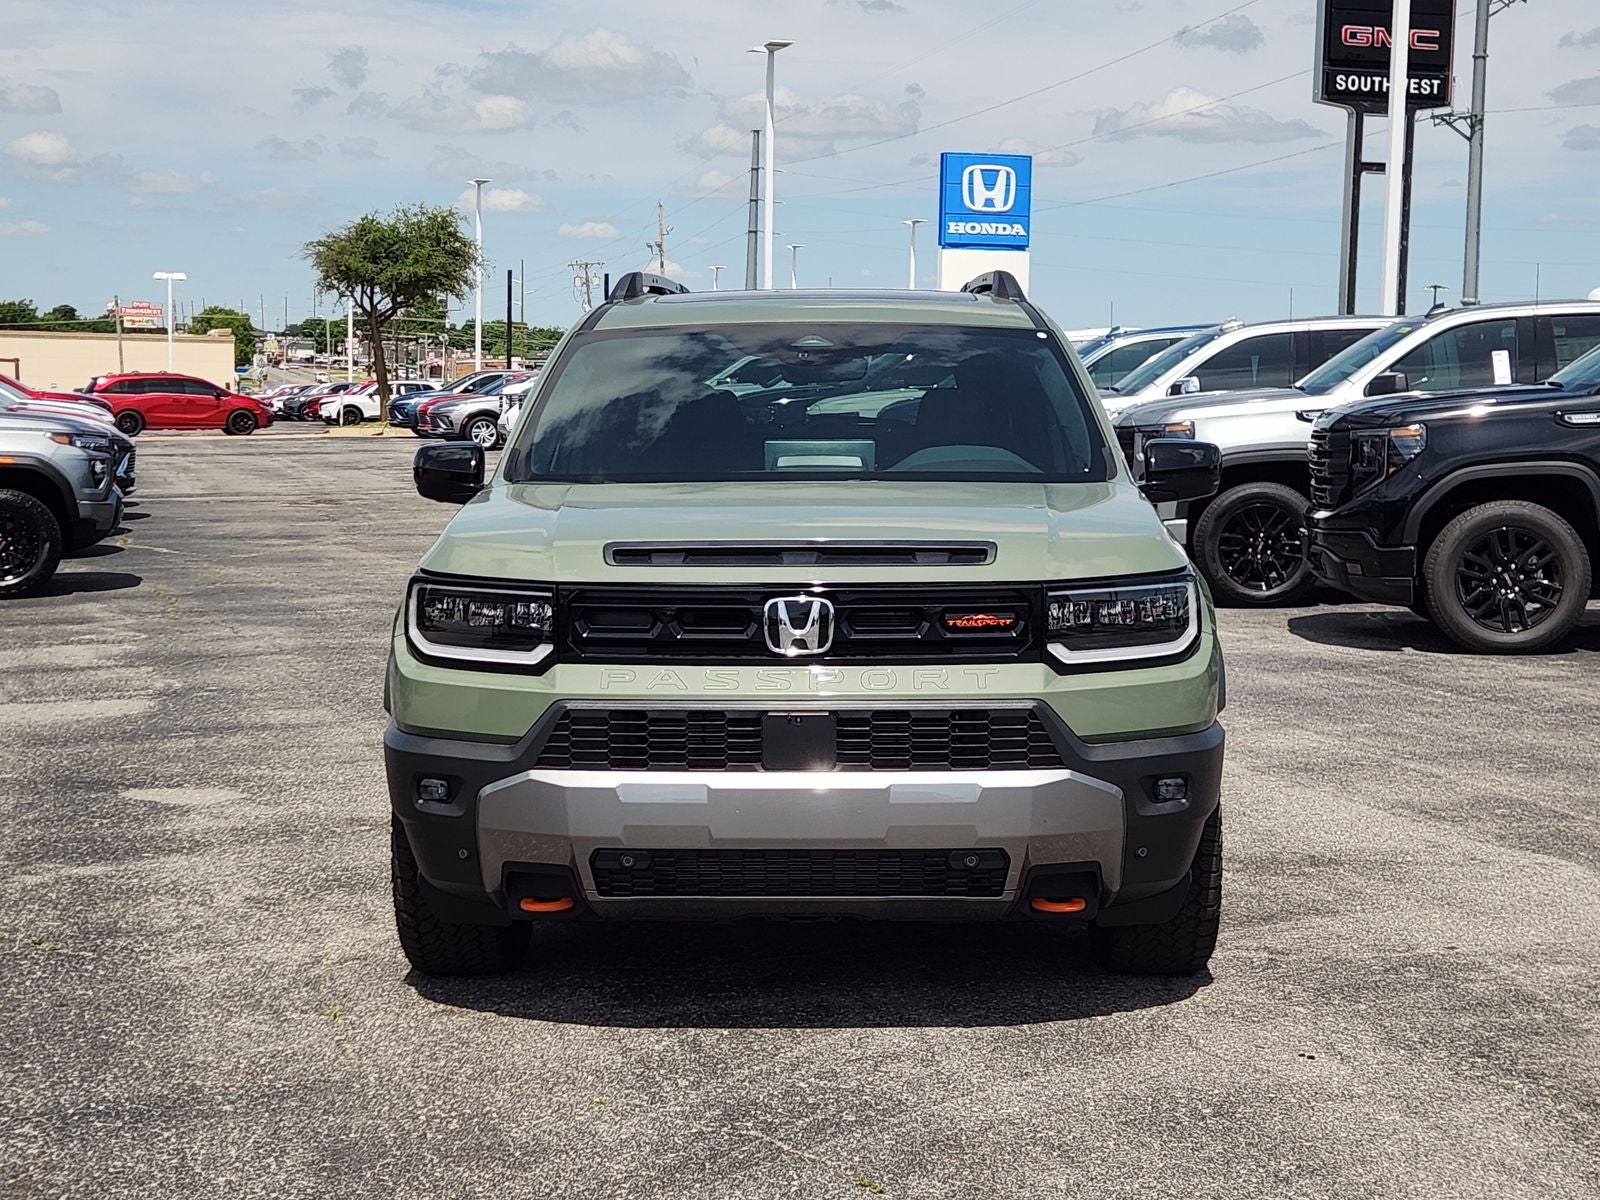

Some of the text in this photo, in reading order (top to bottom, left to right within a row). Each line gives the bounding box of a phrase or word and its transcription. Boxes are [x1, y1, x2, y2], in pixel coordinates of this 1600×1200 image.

[1335, 74, 1441, 94] SOUTHEST
[947, 222, 1027, 235] HONDA
[946, 619, 1014, 627] TRAILSPORT
[600, 668, 1000, 691] PASSPORT
